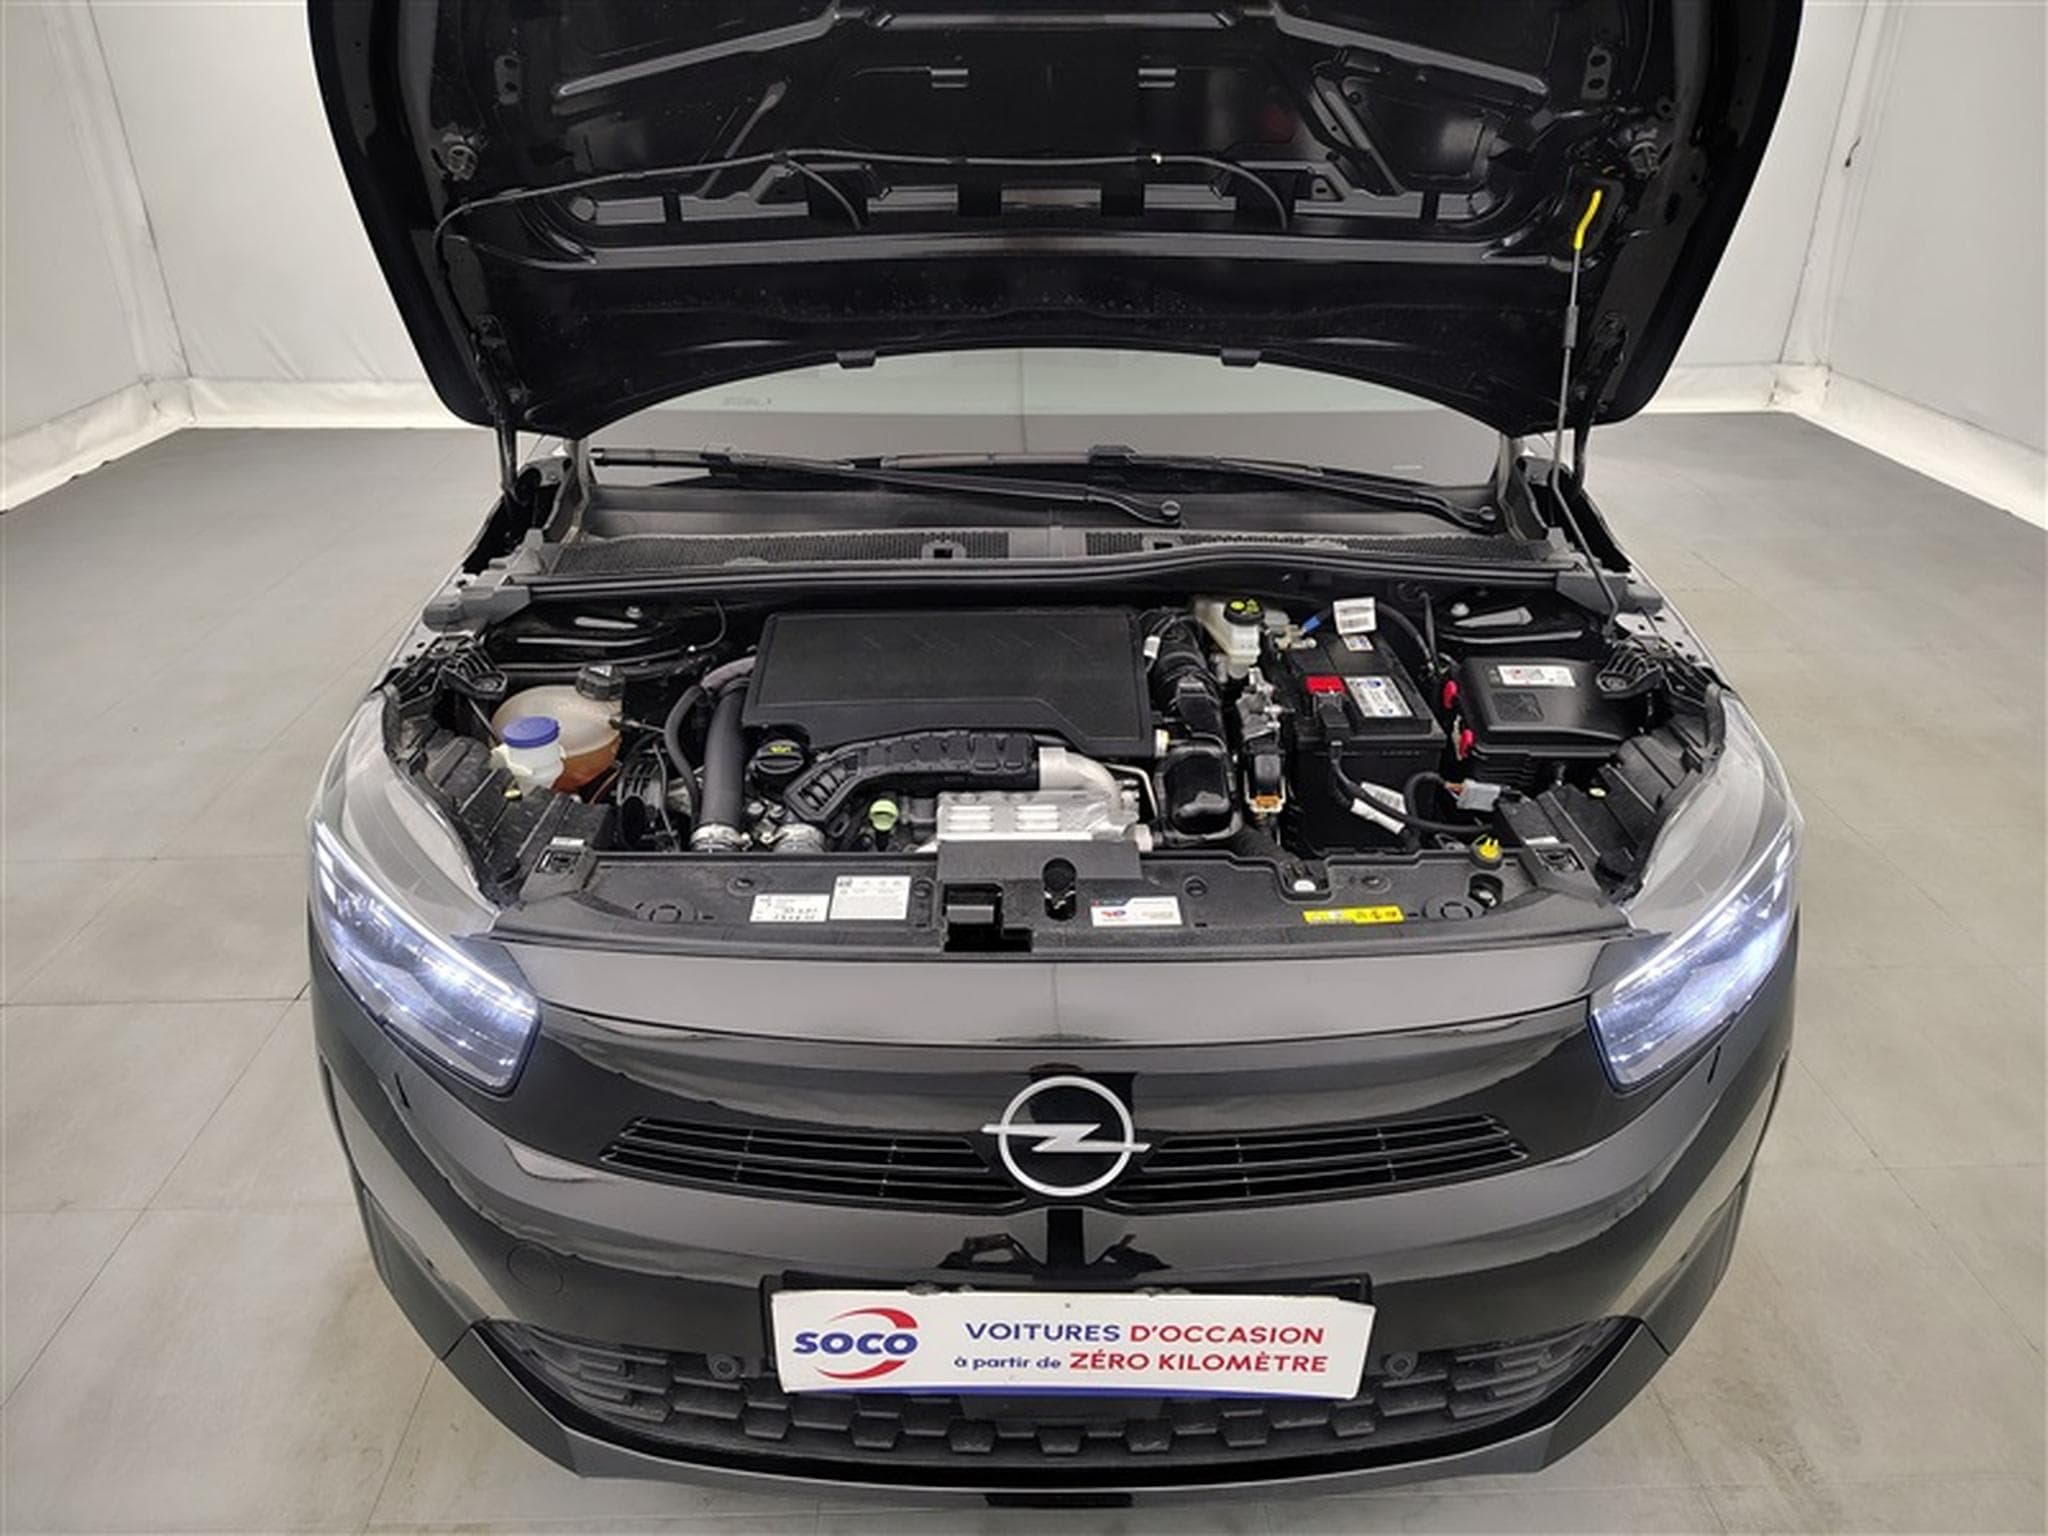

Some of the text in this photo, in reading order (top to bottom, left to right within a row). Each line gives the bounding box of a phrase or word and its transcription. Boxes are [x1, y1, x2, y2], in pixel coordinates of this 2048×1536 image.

[793, 1331, 918, 1355] SOCO
[965, 1323, 1325, 1344] VOITURES D'OCCASION
[954, 1349, 1329, 1373] à partir de ZÉRO KILOMÈTRE
